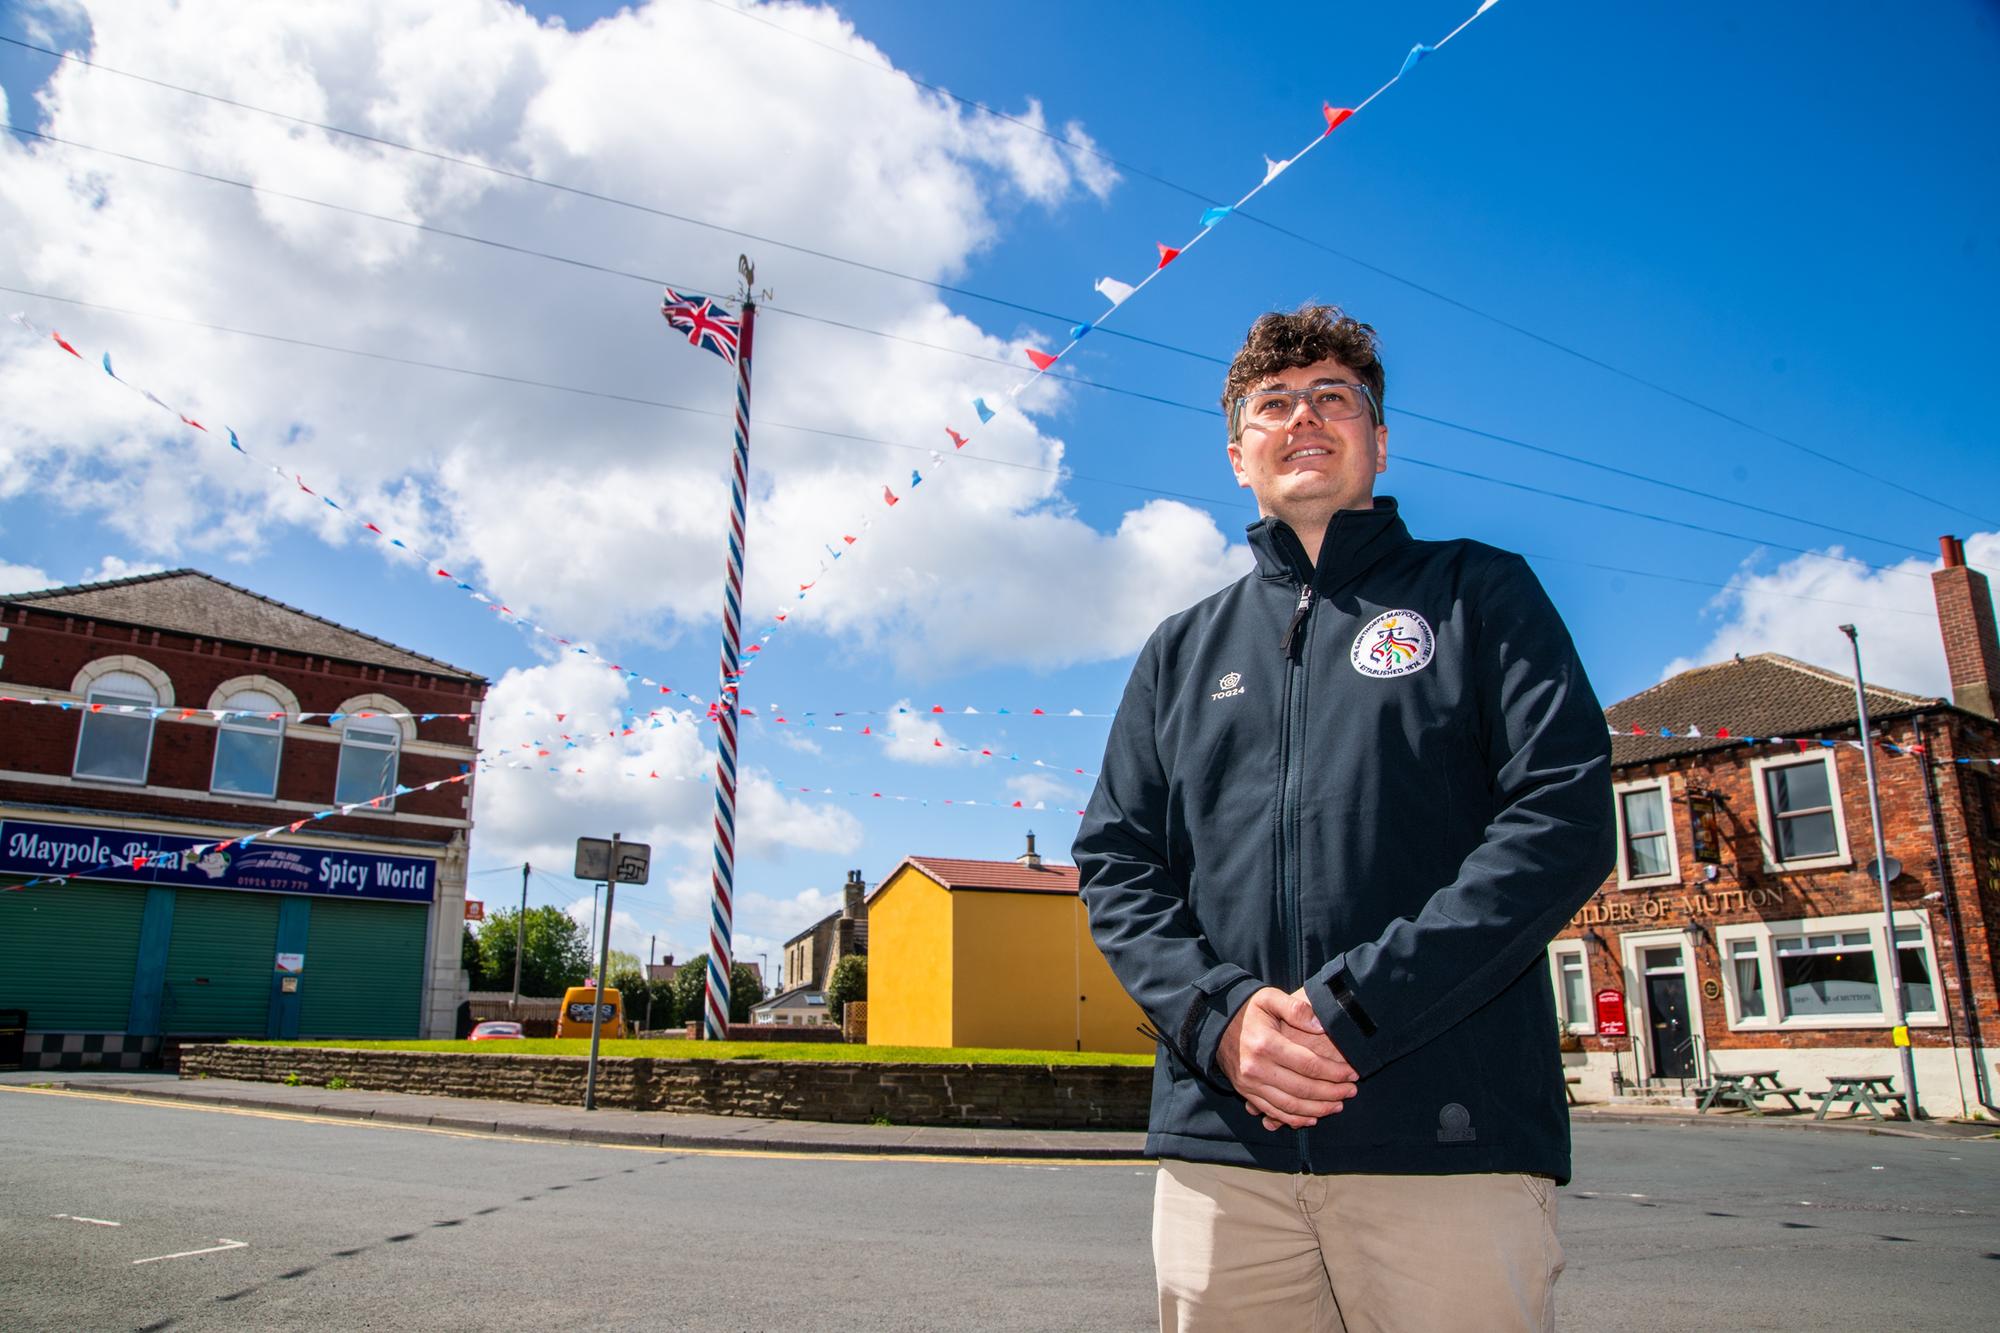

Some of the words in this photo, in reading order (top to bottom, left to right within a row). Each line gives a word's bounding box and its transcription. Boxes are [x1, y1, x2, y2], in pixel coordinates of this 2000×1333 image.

[1387, 611, 1420, 622] MAYPOLE
[1418, 620, 1432, 658] COMMITTEE
[1359, 664, 1404, 676] ESTABLISHED
[1211, 686, 1245, 701] TOG24
[8, 832, 111, 868] Maypole
[319, 857, 368, 891] Spicy
[377, 861, 426, 890] World
[1643, 898, 1670, 918] OF
[1683, 886, 1785, 915] MUTTON
